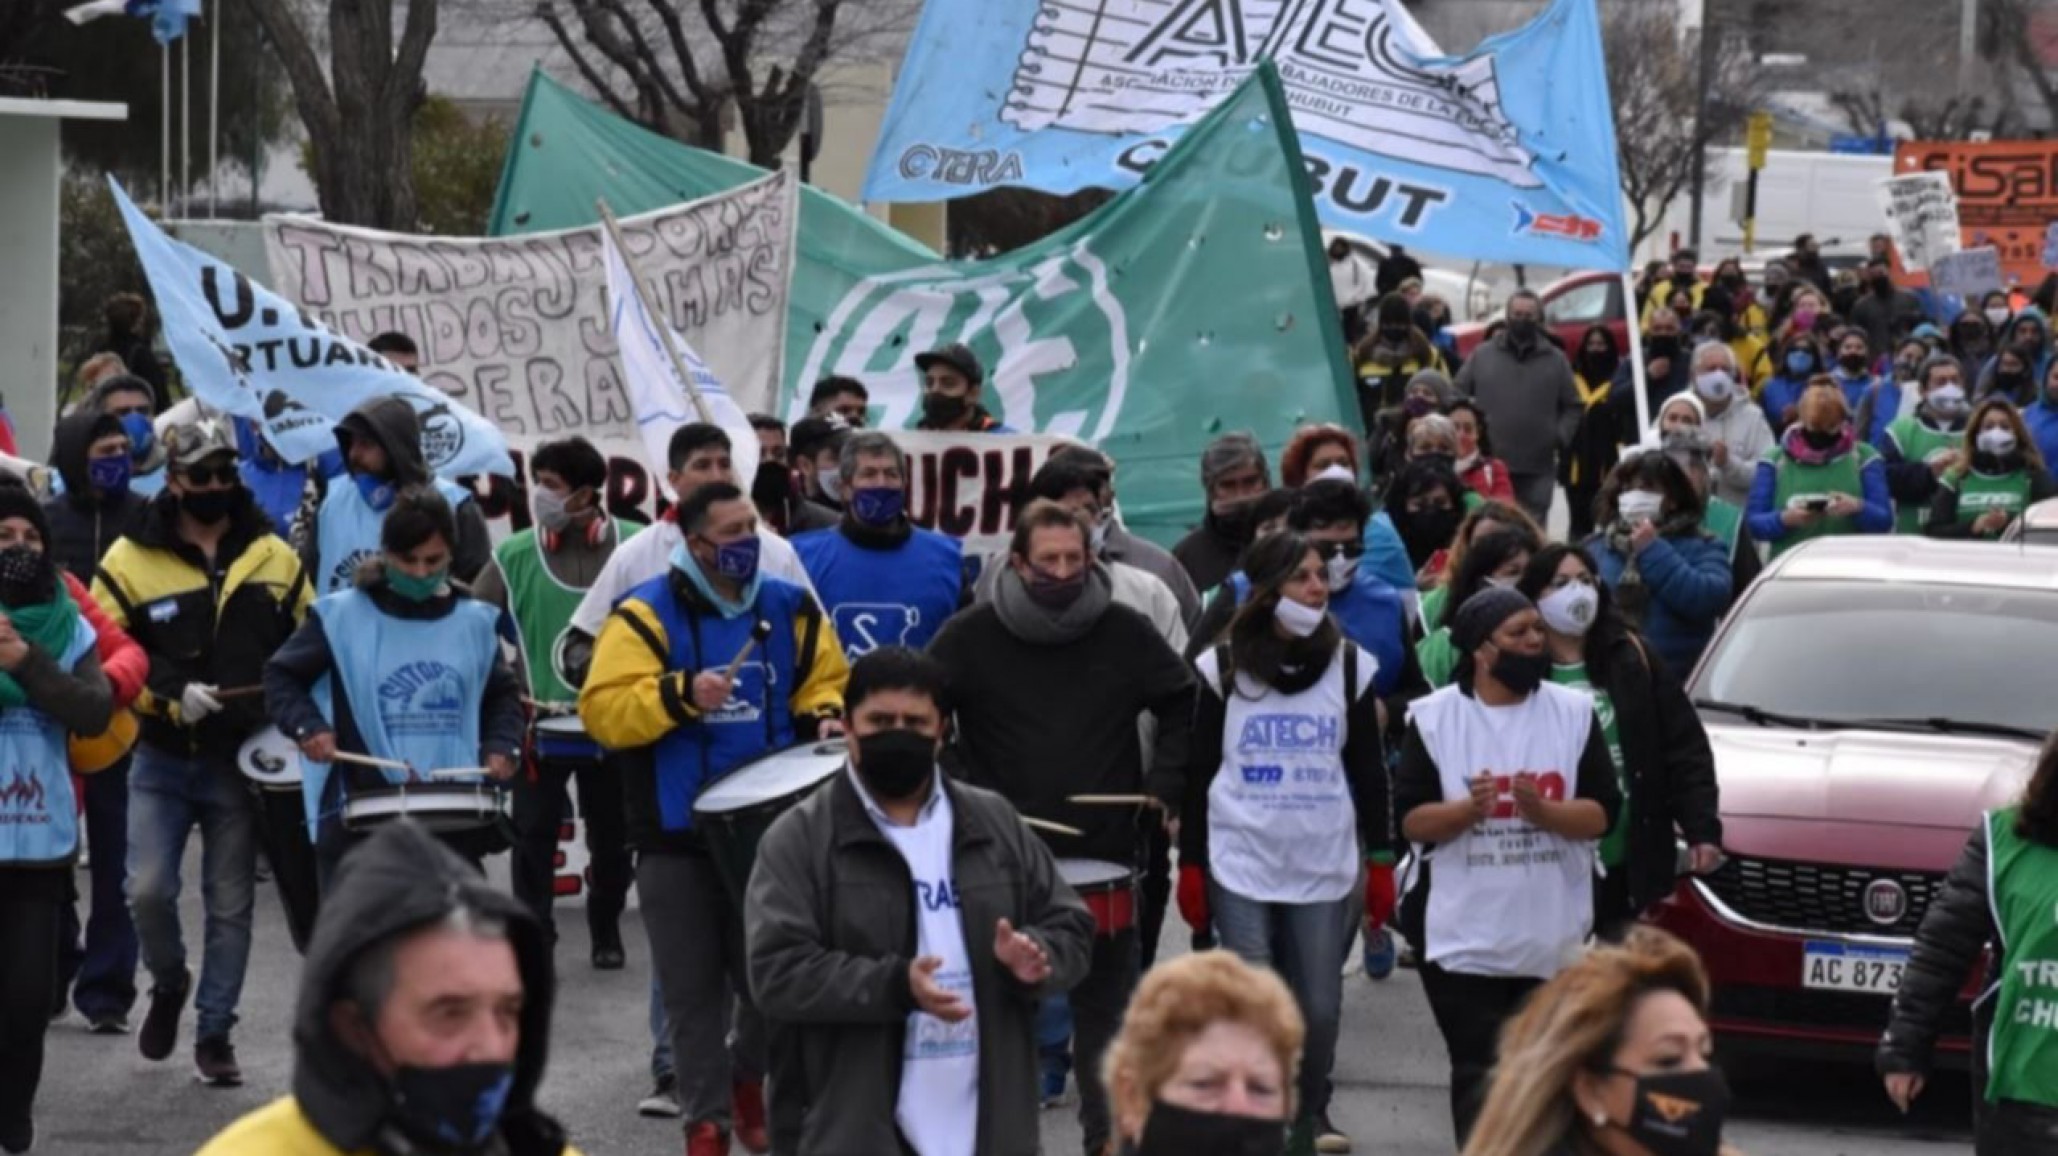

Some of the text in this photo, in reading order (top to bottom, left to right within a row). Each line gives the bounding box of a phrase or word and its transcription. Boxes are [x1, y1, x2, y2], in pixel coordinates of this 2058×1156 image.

[1121, 0, 1458, 92] ATEC
[1281, 64, 1394, 101] BAJADORES
[1286, 91, 1354, 118] HUBUT
[1116, 140, 1446, 228] CBUT
[316, 243, 776, 368] NIDOS JMAS
[1238, 713, 1338, 750] ATECH
[1811, 957, 1903, 989] AC 873
[2016, 960, 2058, 988] TR
